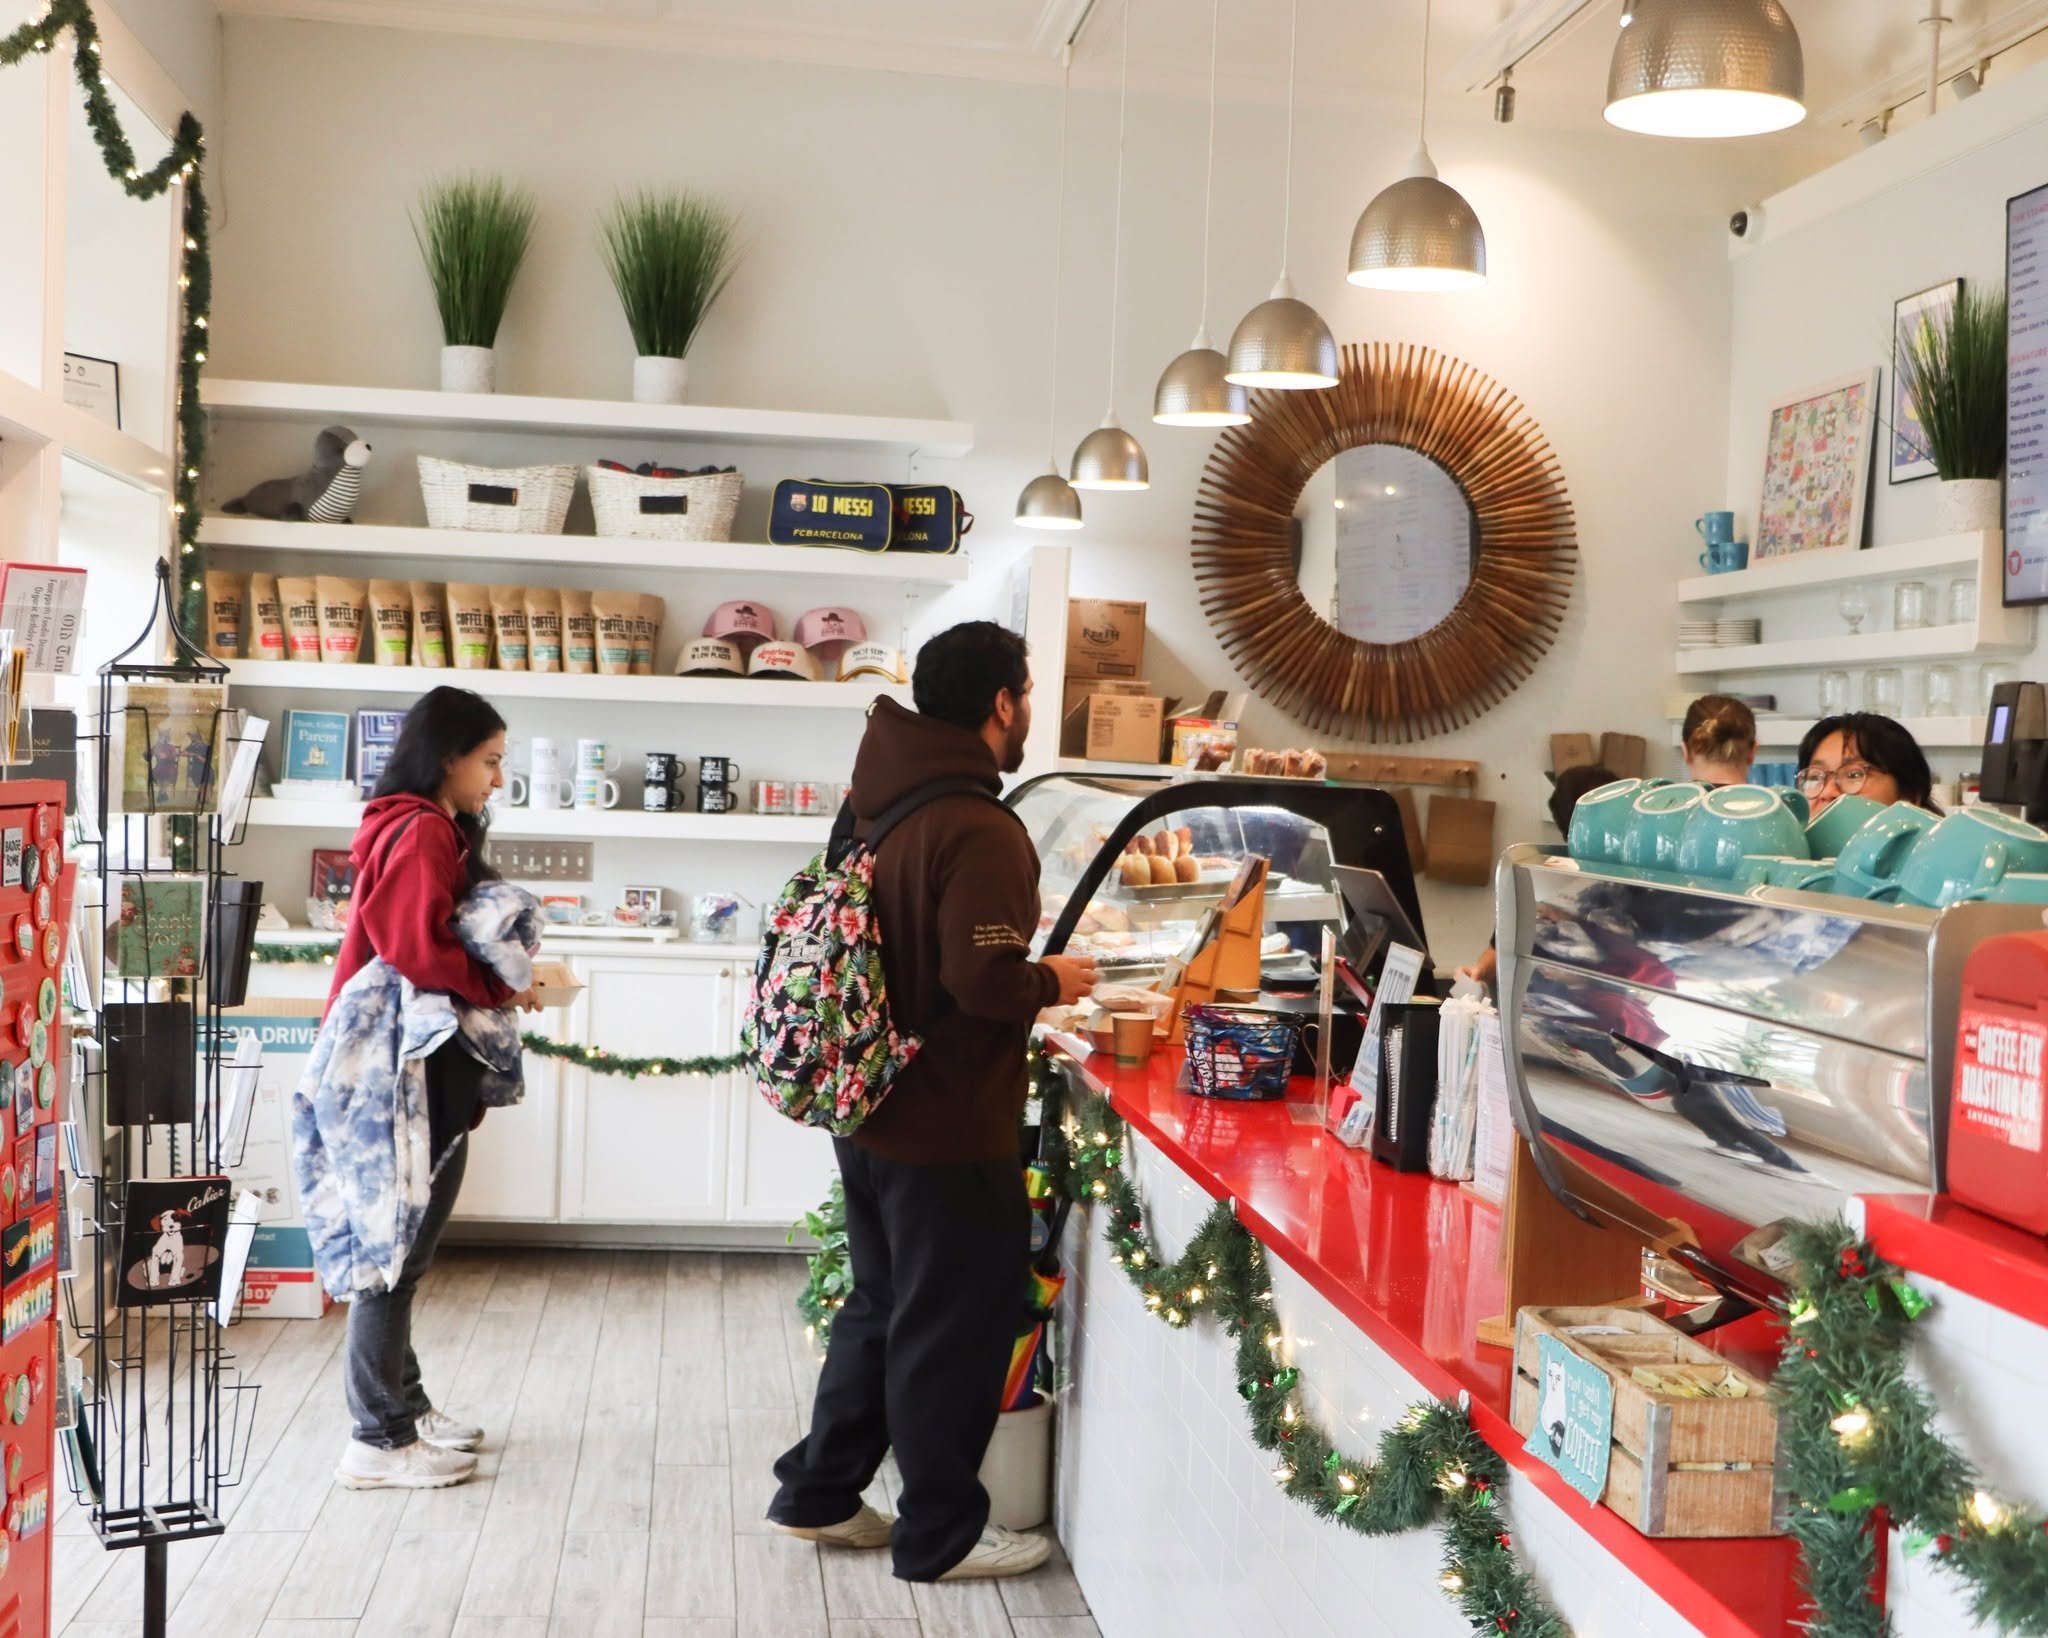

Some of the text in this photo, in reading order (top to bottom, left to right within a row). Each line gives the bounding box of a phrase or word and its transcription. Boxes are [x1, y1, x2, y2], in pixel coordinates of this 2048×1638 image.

[812, 495, 873, 517] 10 MESSI
[325, 606, 352, 620] COFFEE
[377, 609, 404, 623] COFFEE
[456, 612, 482, 626] COFFEE
[498, 615, 524, 629] COFFEE
[531, 616, 557, 629] COFFEE
[600, 618, 624, 631] COFFEE
[298, 729, 338, 744] Parent
[262, 1027, 320, 1045] DRIVE
[1977, 1023, 2019, 1073] COFFEE
[2018, 1031, 2043, 1079] FOX
[1961, 1064, 2020, 1120] ROASTING
[187, 1185, 226, 1213] Cahier
[1565, 1416, 1603, 1485] COFFEE
